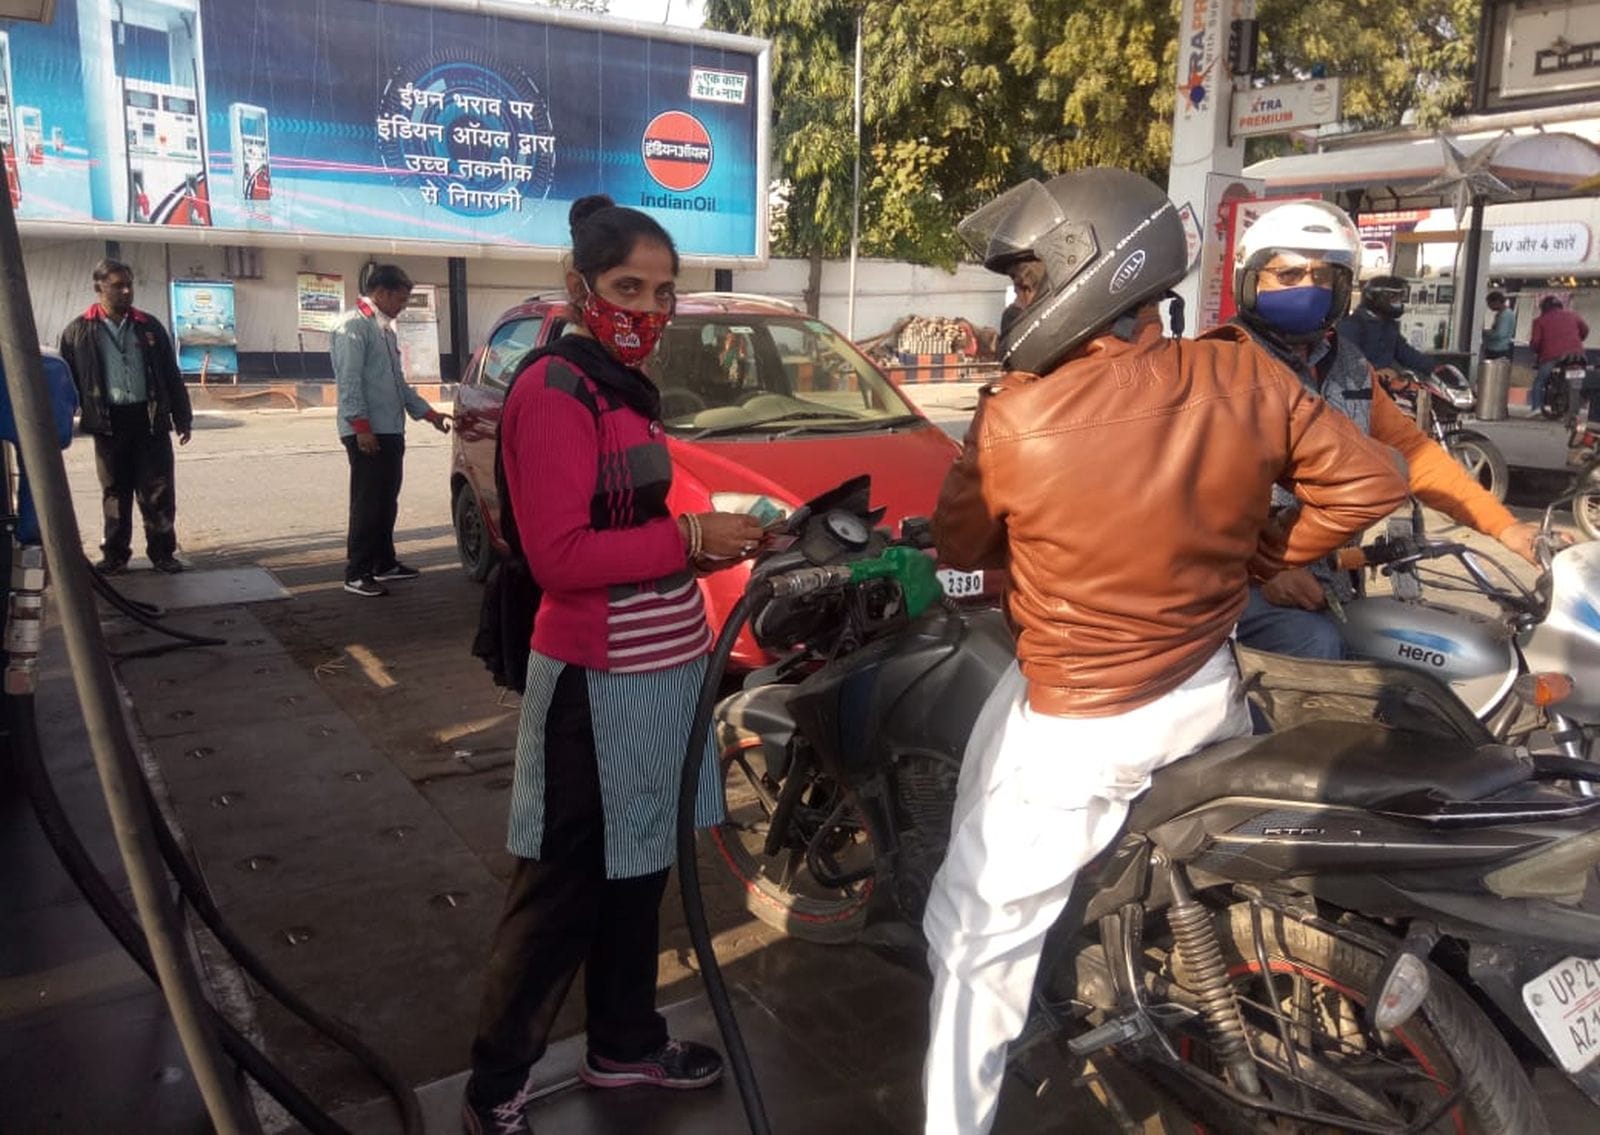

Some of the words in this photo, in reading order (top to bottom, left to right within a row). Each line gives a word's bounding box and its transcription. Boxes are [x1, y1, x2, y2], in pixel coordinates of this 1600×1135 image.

[453, 93, 501, 116] भराव
[510, 100, 534, 120] पर
[1239, 111, 1294, 128] PREMIUM
[377, 113, 444, 143] इंडियन
[452, 121, 510, 149] ऑयल
[518, 133, 555, 154] द्वारा
[404, 154, 450, 176] उच्च
[457, 156, 532, 182] तकनीक
[420, 179, 439, 205] से
[448, 184, 522, 211] निगरानी
[641, 191, 716, 212] IndianOil
[1516, 236, 1537, 252] और
[1540, 237, 1549, 251] 4
[1398, 643, 1445, 667] Hero
[1549, 969, 1576, 1005] UP
